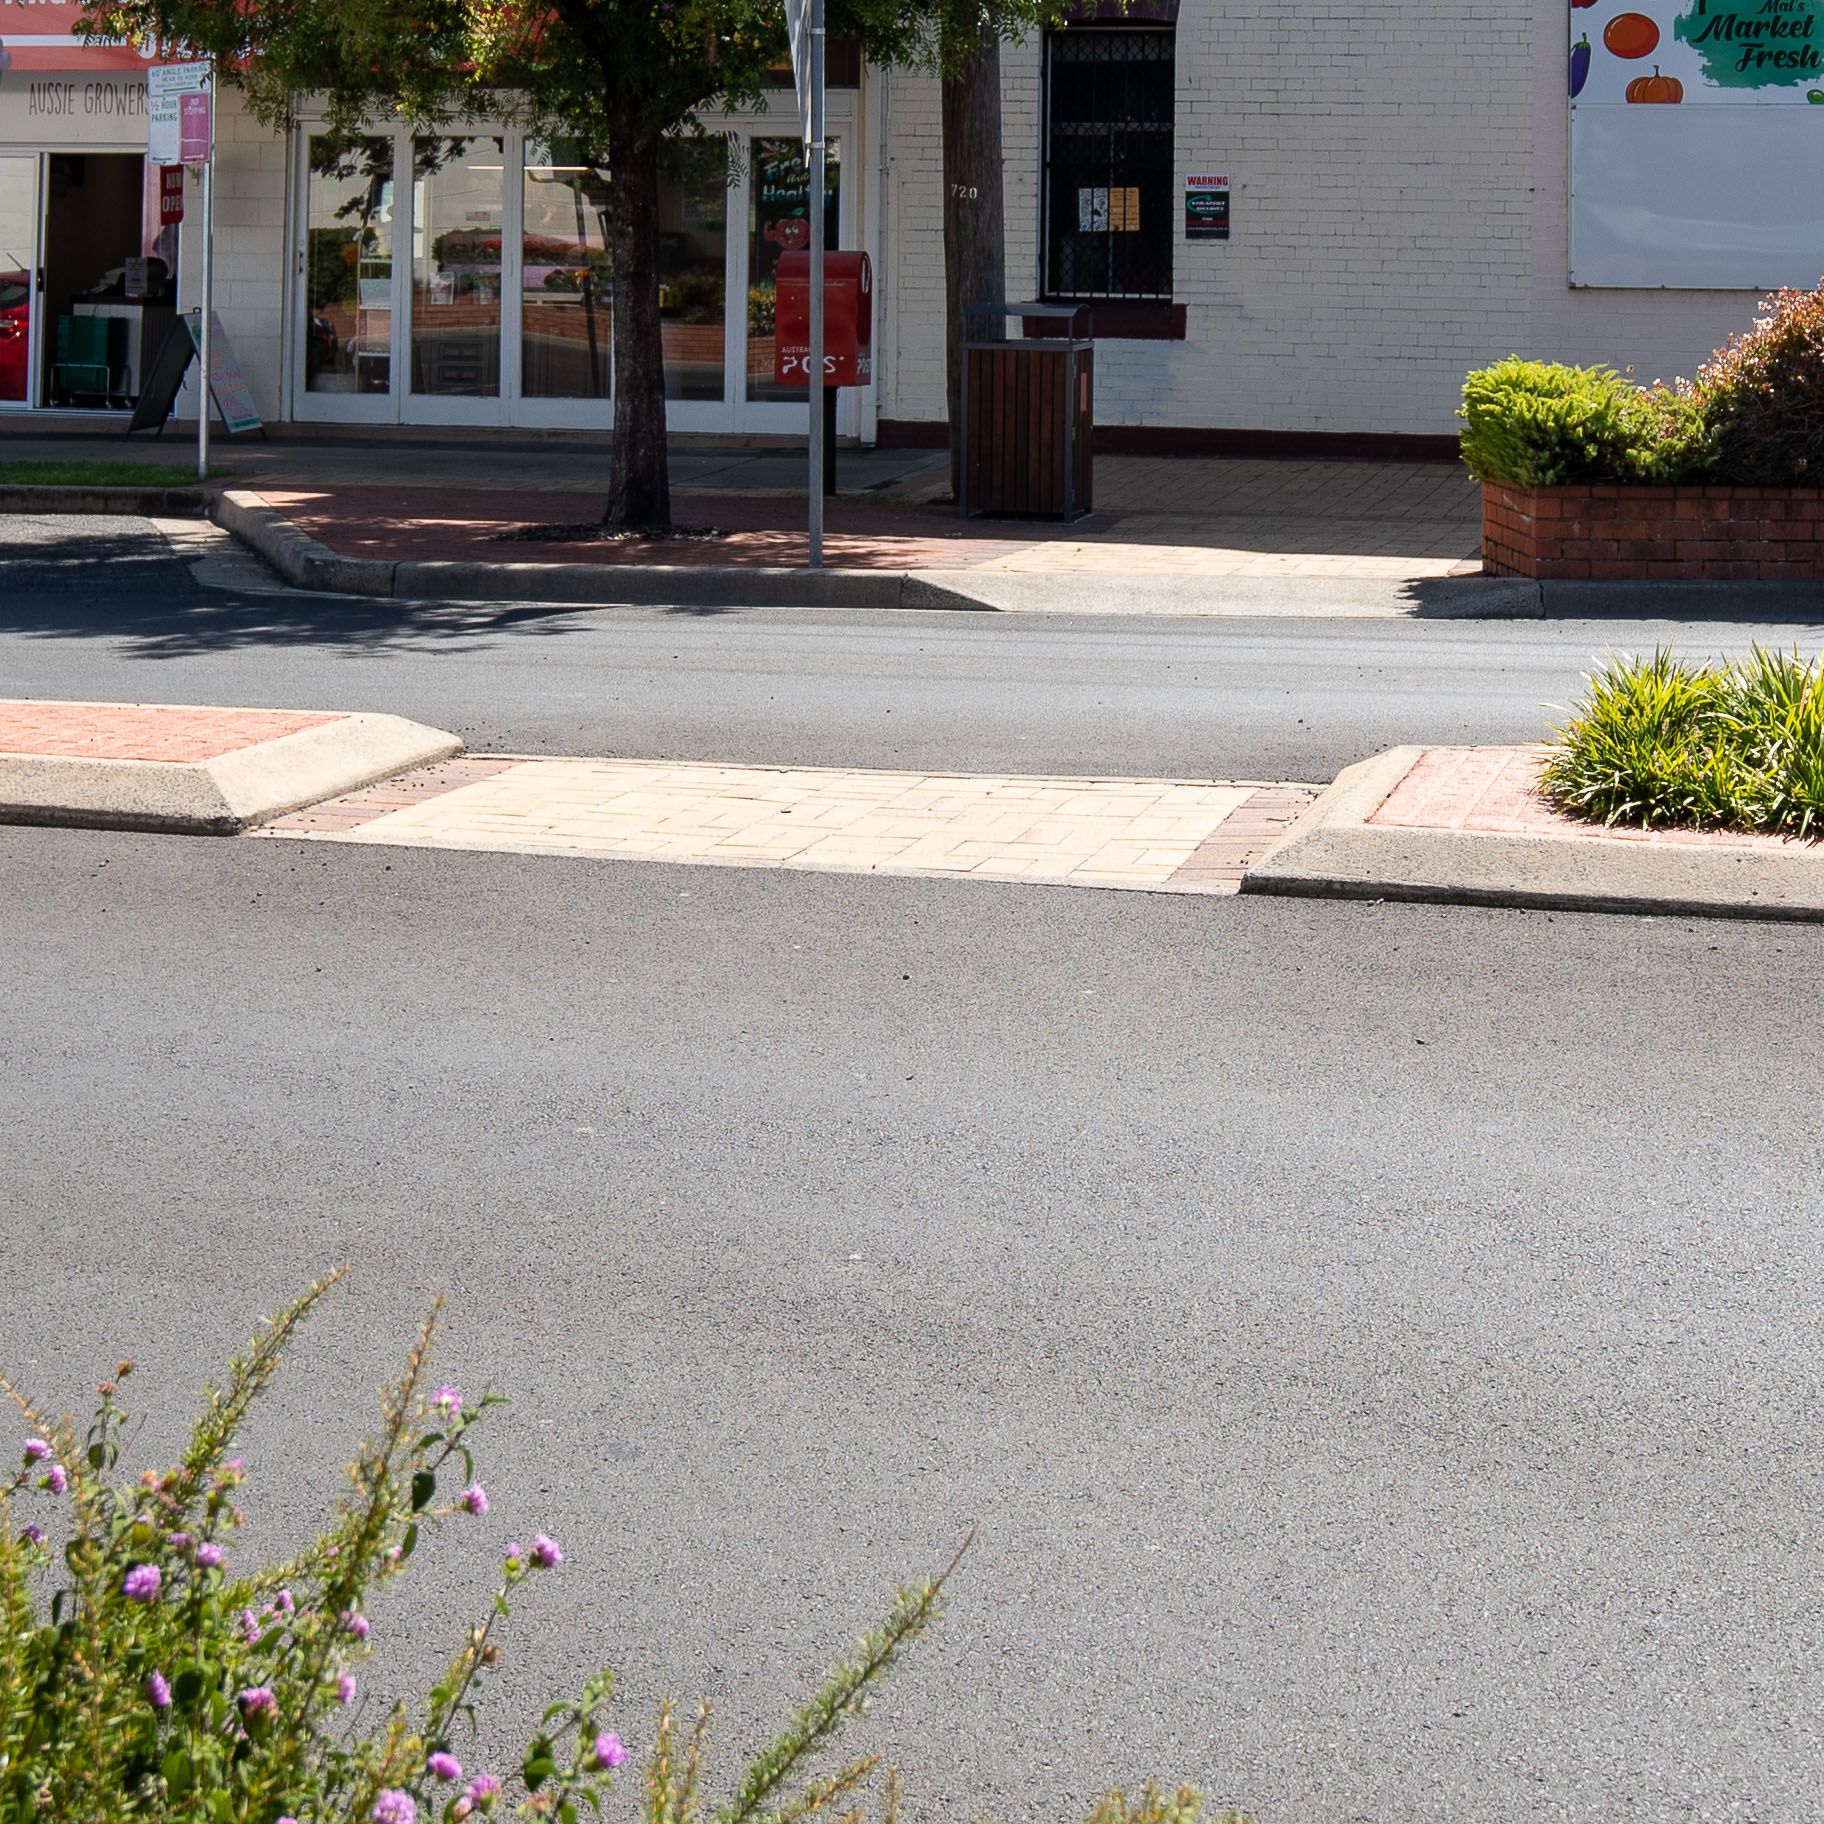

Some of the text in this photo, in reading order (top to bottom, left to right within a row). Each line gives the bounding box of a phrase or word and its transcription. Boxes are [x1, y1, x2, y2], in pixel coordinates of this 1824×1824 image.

[1757, 0, 1805, 14] Mal's
[1692, 13, 1815, 43] Market
[1734, 42, 1823, 73] Fresh
[28, 82, 75, 116] AUSSIE
[151, 112, 178, 122] PARKING
[1187, 175, 1229, 186] WARNING
[951, 183, 978, 200] 720
